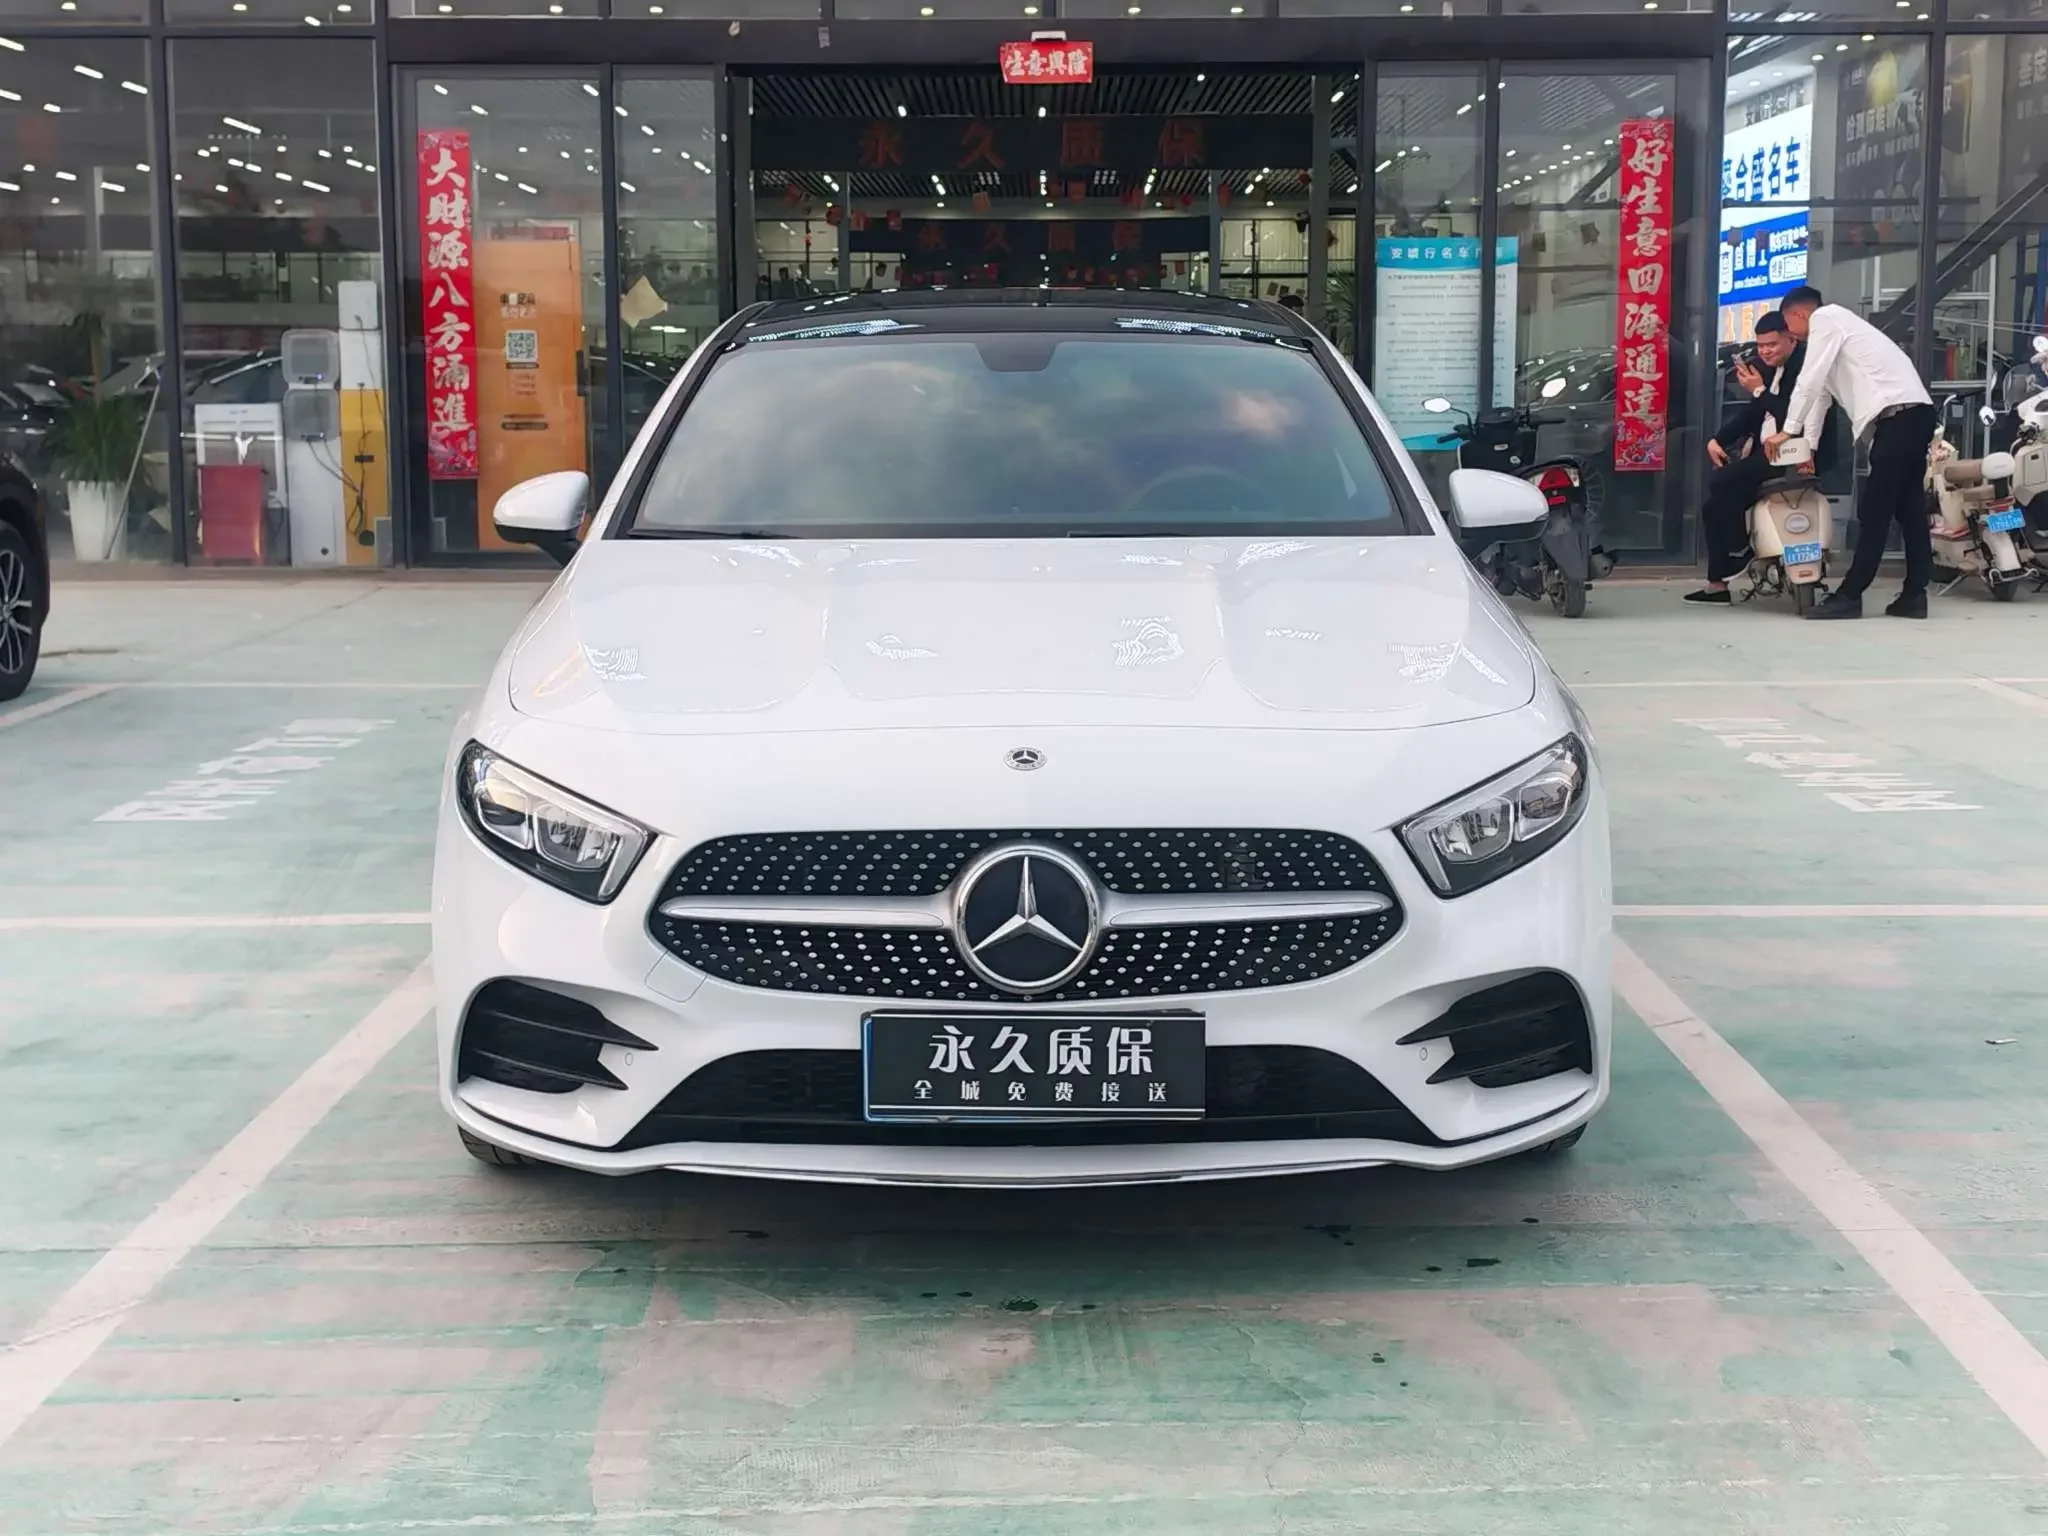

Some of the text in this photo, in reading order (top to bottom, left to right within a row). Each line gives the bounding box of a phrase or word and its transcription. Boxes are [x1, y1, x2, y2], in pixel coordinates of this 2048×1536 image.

[1005, 48, 1088, 77] 生意興隆
[859, 119, 1206, 168] 永久质保
[1622, 138, 1669, 426] 好生意四海通達
[928, 1024, 1153, 1075] 永久质保
[914, 1080, 1168, 1102] 全城免费接送
